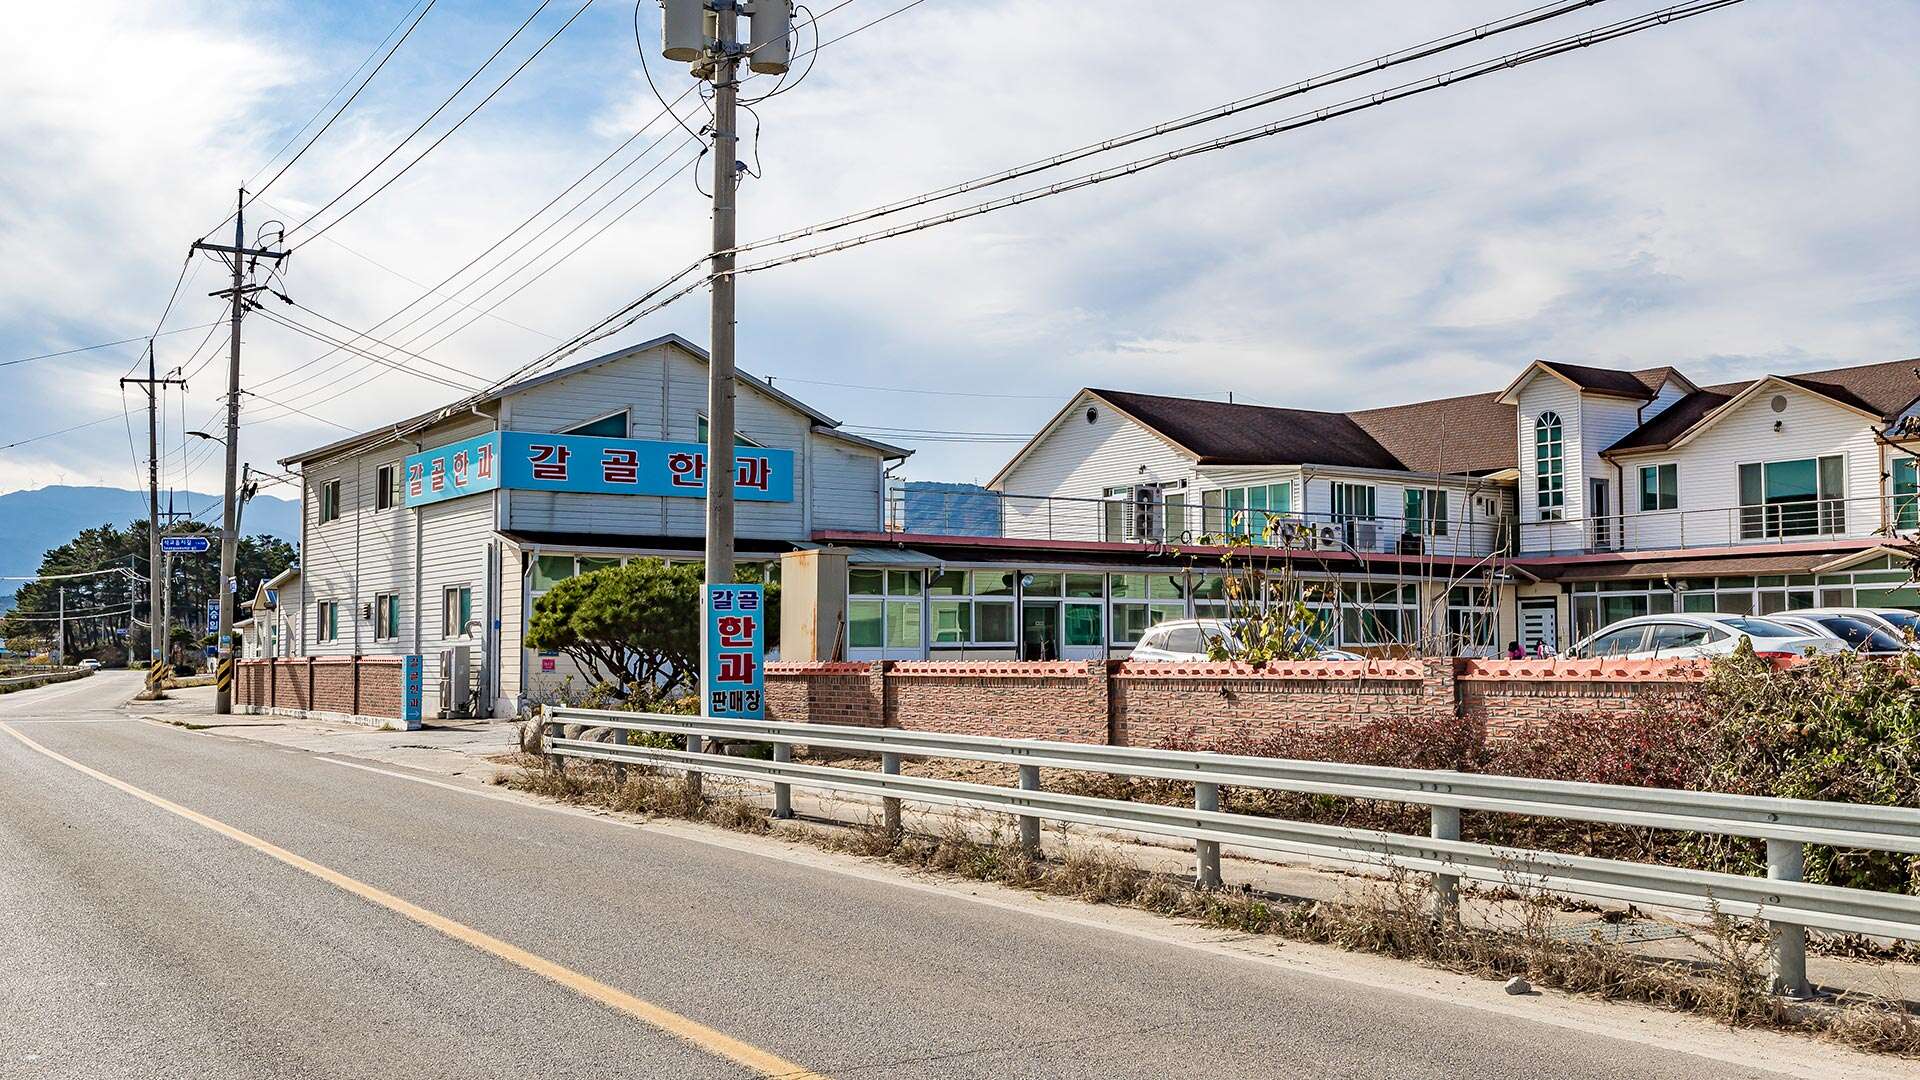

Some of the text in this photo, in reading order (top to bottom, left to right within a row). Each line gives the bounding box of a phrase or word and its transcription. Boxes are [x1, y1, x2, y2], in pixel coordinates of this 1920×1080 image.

[409, 443, 493, 496] 갈골한과
[529, 445, 771, 490] 갈골한과
[712, 590, 759, 611] 갈골
[717, 615, 757, 685] 한과
[712, 690, 760, 712] 판매장
